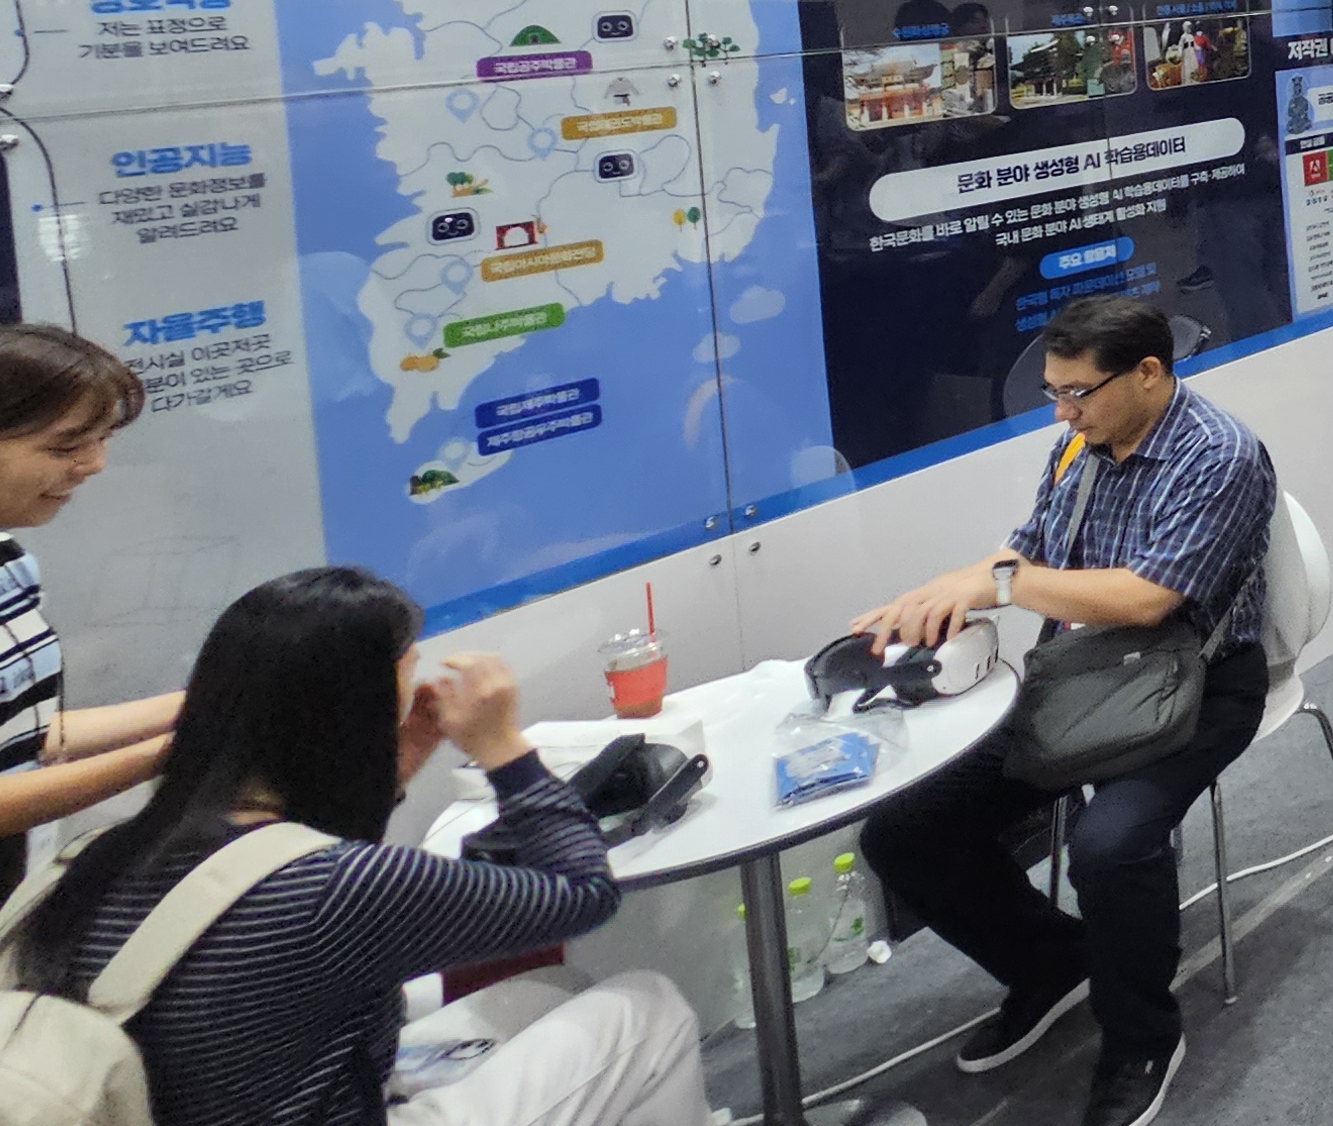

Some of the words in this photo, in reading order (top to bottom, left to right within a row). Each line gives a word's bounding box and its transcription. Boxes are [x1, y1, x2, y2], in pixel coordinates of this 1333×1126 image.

[98, 19, 141, 37] 저는
[146, 15, 229, 36] 표정으로
[78, 39, 145, 60] 기분을
[149, 35, 251, 56] 보여드려요
[1287, 37, 1328, 60] 저작권
[111, 142, 252, 178] 인공지능
[957, 169, 992, 194] 문화
[996, 164, 1030, 187] 분야
[1033, 155, 1080, 180] 생성형
[1083, 152, 1101, 171] AI
[1104, 136, 1186, 166] 학습용데이터
[98, 184, 163, 206] 다양한
[168, 172, 267, 198] 문화정보를
[178, 193, 262, 219] 실감나게
[135, 216, 240, 245] 알려드려요
[869, 225, 934, 252] 한국문화를
[936, 220, 964, 238] 바로
[963, 216, 990, 233] 알릴
[991, 212, 1004, 227] 수
[1005, 208, 1029, 225] 있는
[1030, 202, 1053, 220] 문화
[1054, 198, 1078, 216] 분야
[1078, 191, 1110, 211] 생성형
[1112, 188, 1124, 201] AI
[995, 228, 1020, 247] 국내
[1021, 224, 1043, 242] 문화
[1045, 220, 1068, 237] 분야
[1069, 217, 1082, 231] AI
[1082, 211, 1115, 229] 생태계
[123, 299, 267, 347] 자율주행
[125, 350, 186, 376] 전시실
[191, 333, 272, 362] 이곳저곳
[190, 364, 230, 385] 있는
[236, 350, 294, 375] 곳으로
[151, 379, 253, 413] 다가갈게요
